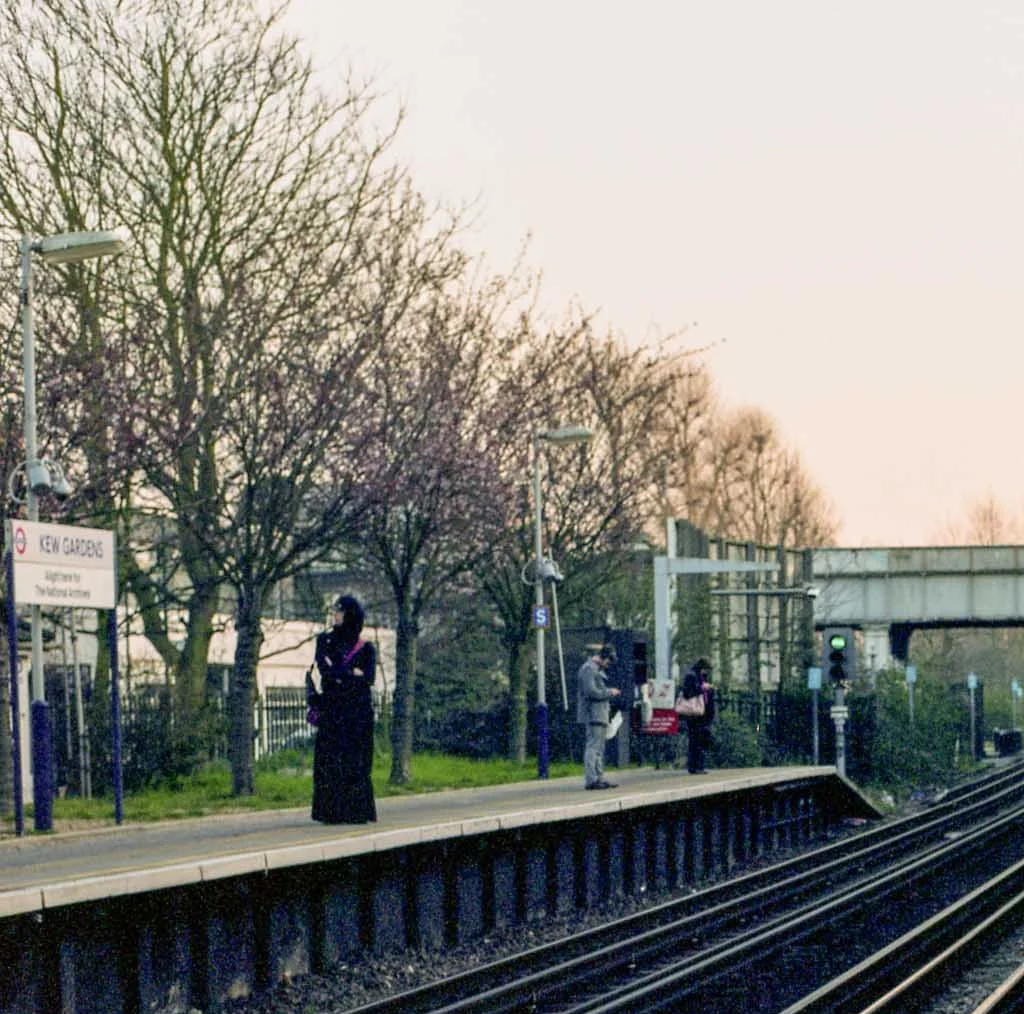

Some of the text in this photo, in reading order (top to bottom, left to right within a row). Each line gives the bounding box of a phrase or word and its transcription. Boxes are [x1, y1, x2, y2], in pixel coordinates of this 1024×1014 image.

[39, 534, 60, 555] KEW
[62, 536, 104, 559] GARDENS
[536, 608, 546, 624] S
